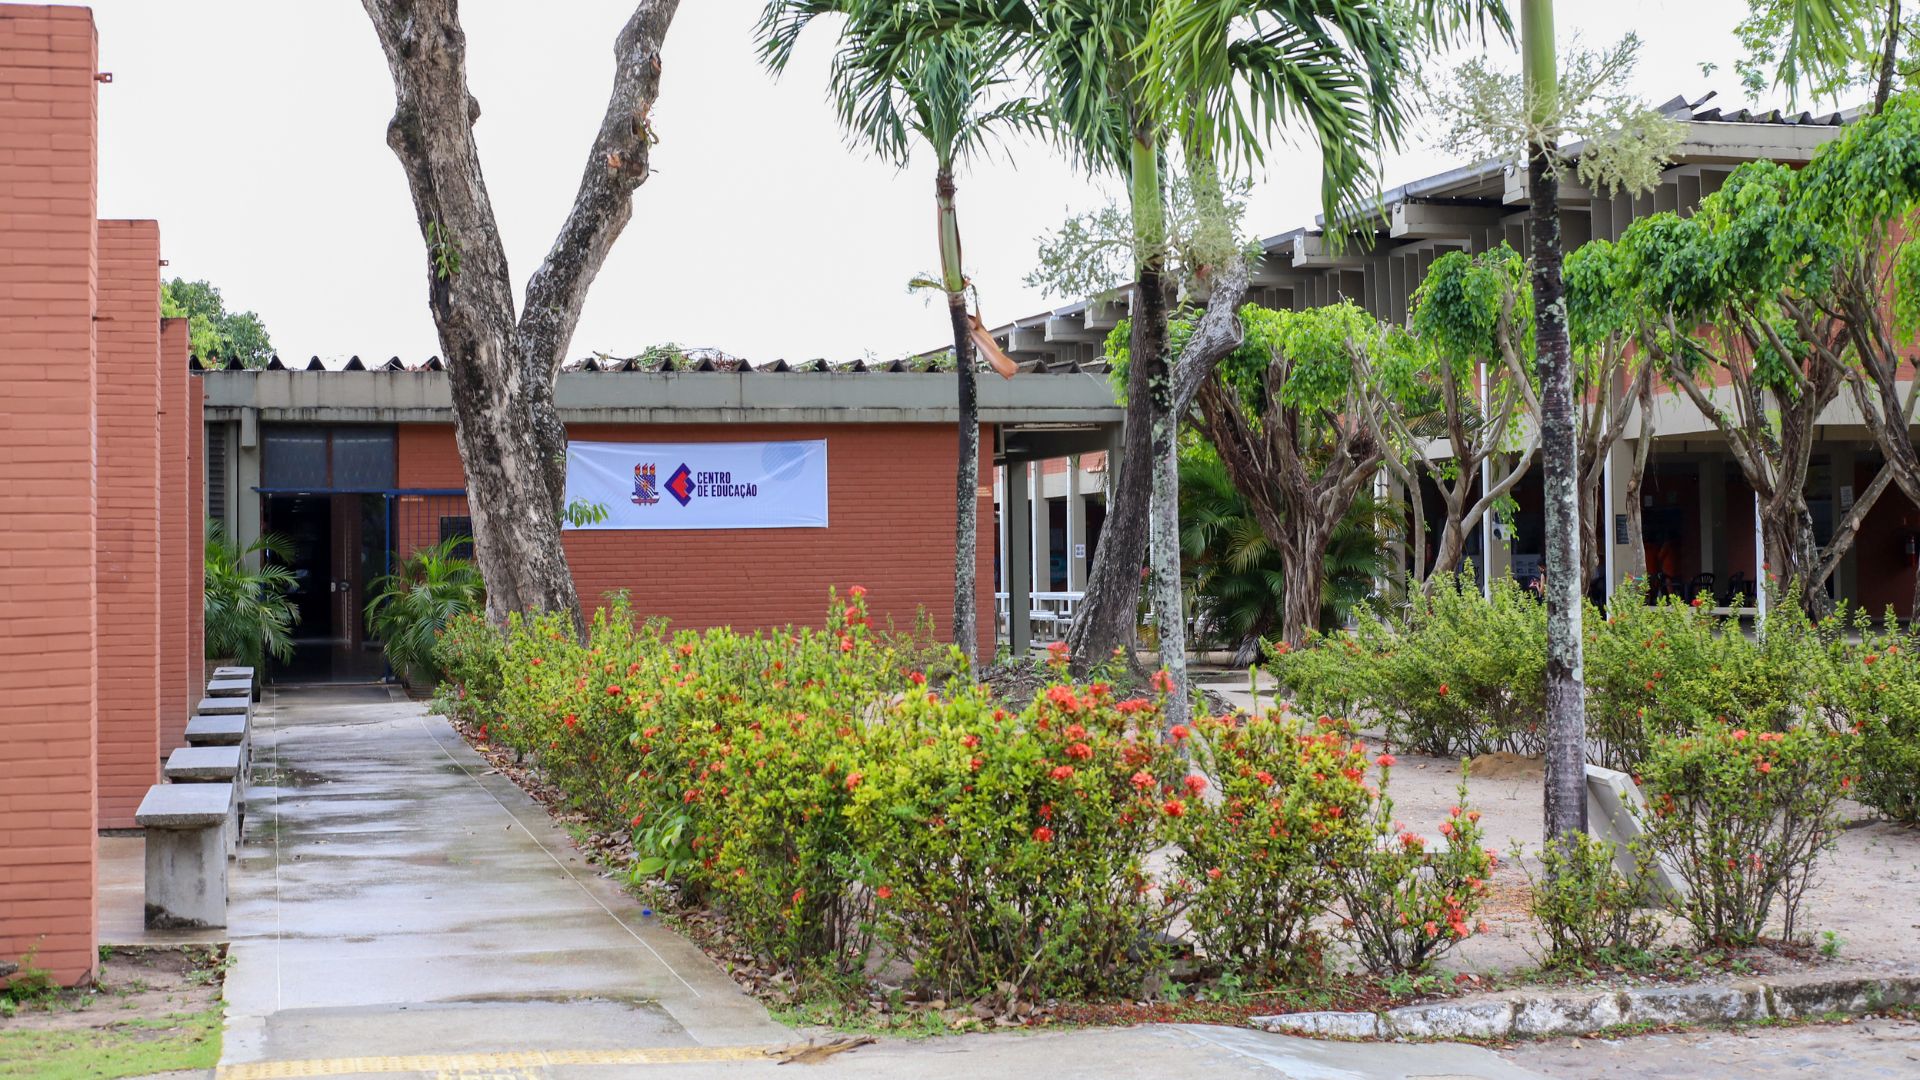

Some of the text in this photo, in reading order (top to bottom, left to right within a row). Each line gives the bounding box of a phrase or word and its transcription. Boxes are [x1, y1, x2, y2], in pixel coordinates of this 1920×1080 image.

[697, 471, 731, 484] CENTRO
[697, 483, 757, 499] DE EDUCAÇÃO
